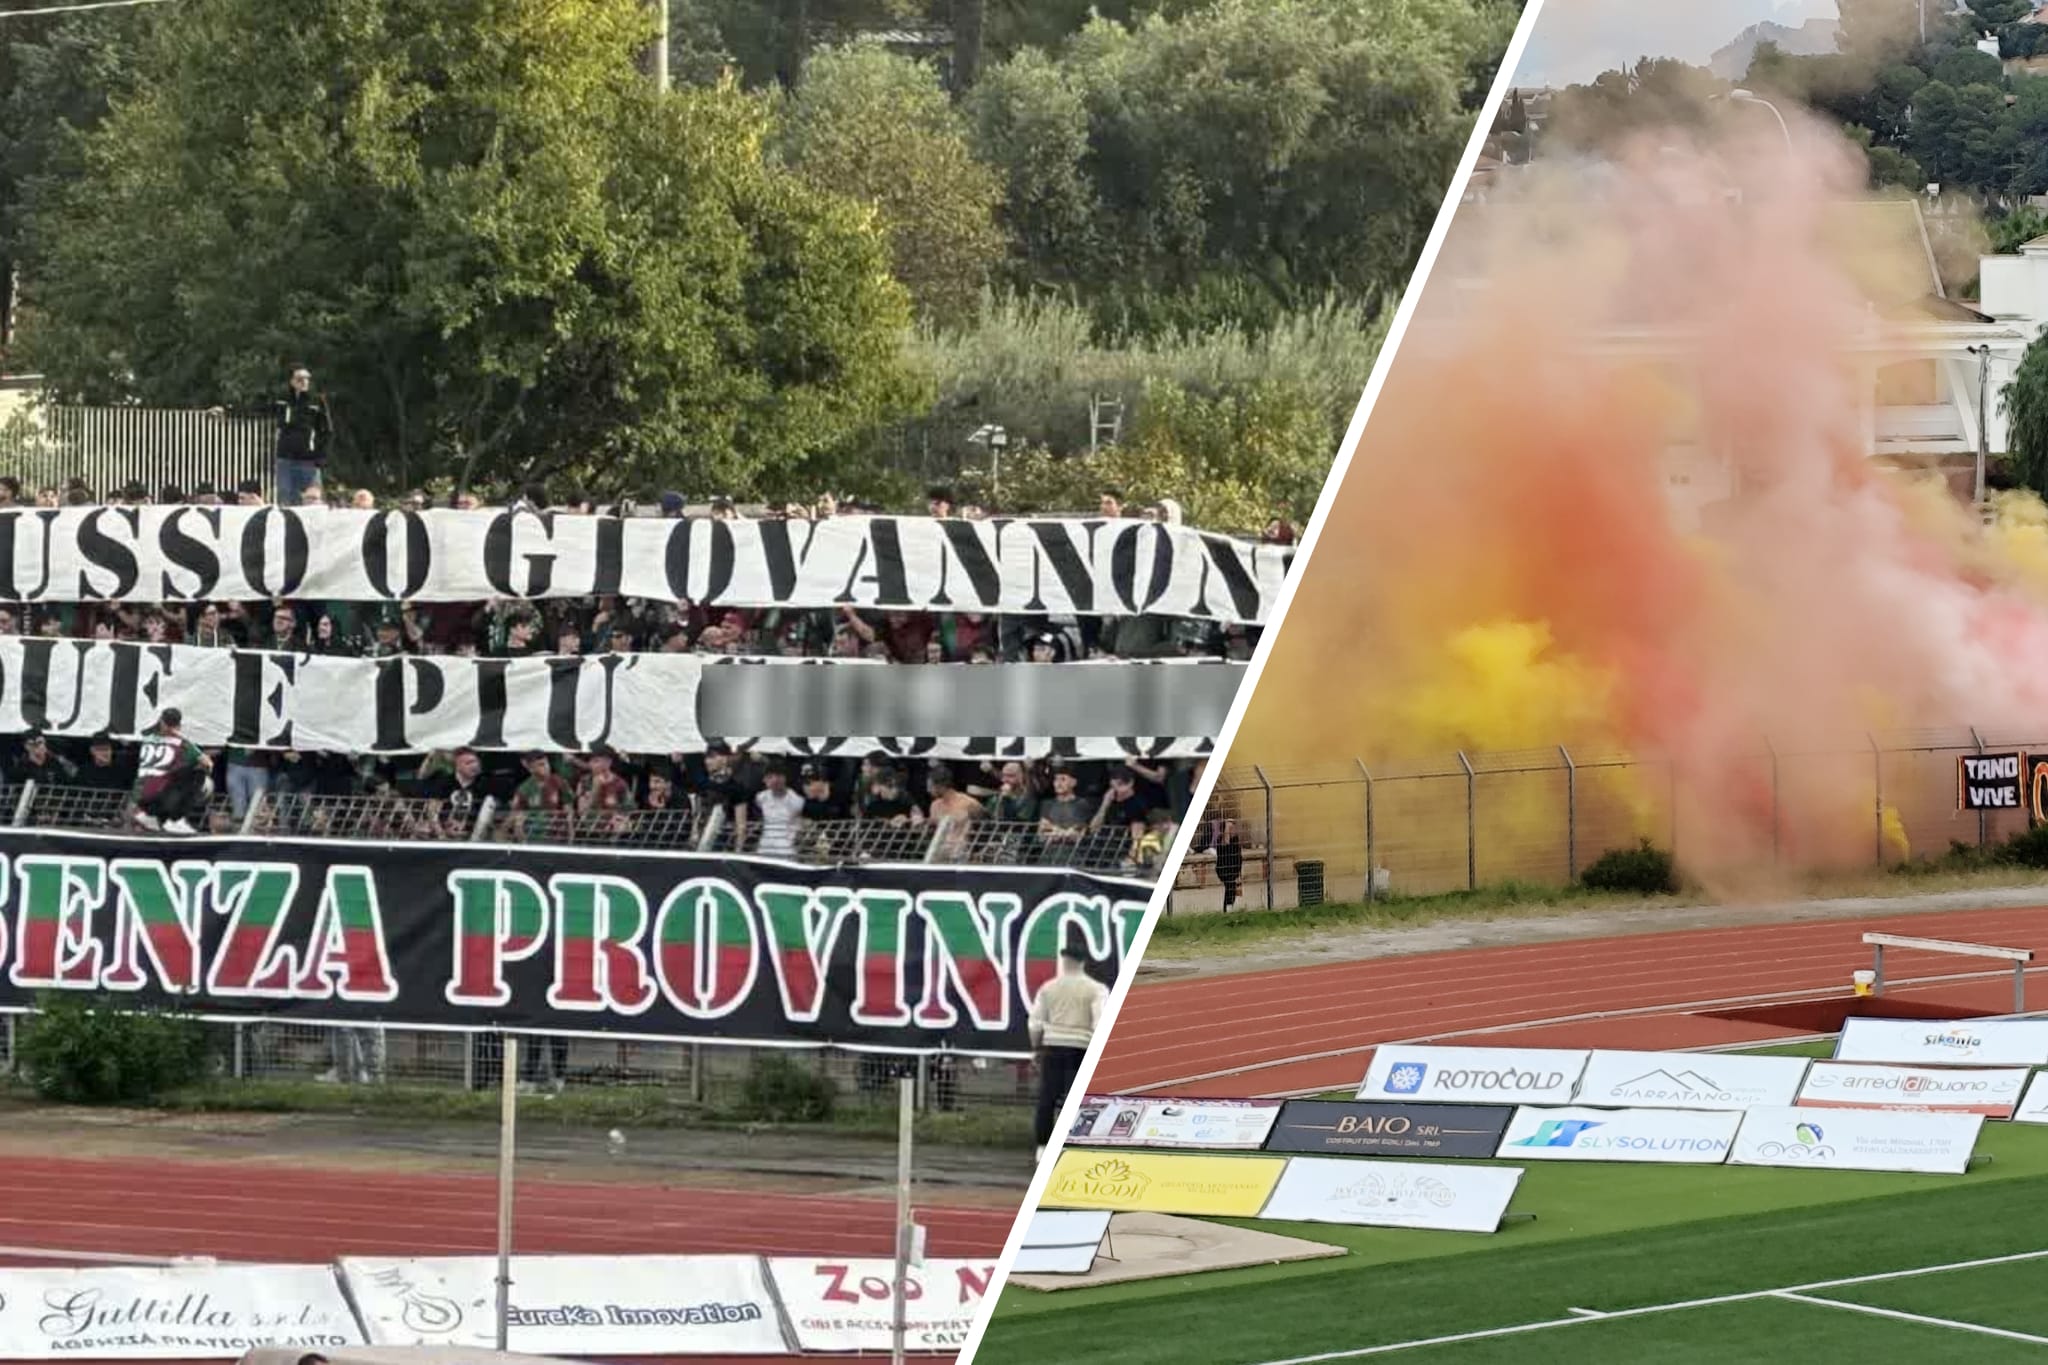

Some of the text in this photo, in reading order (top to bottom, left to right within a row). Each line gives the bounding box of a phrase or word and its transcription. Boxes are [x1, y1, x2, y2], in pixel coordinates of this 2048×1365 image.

[362, 508, 430, 599] O
[484, 509, 1294, 620] GIOVANNON
[0, 639, 173, 737] UE
[1965, 757, 2018, 779] TANO
[1969, 786, 2016, 806] VIVE
[0, 854, 1149, 1030] ENZA PROVINC
[1433, 1067, 1564, 1090] ROTOCOLD
[1337, 1116, 1411, 1134] BAIO
[1578, 1136, 1729, 1151] SLYSOLUTION
[604, 1302, 761, 1326] Innovation
